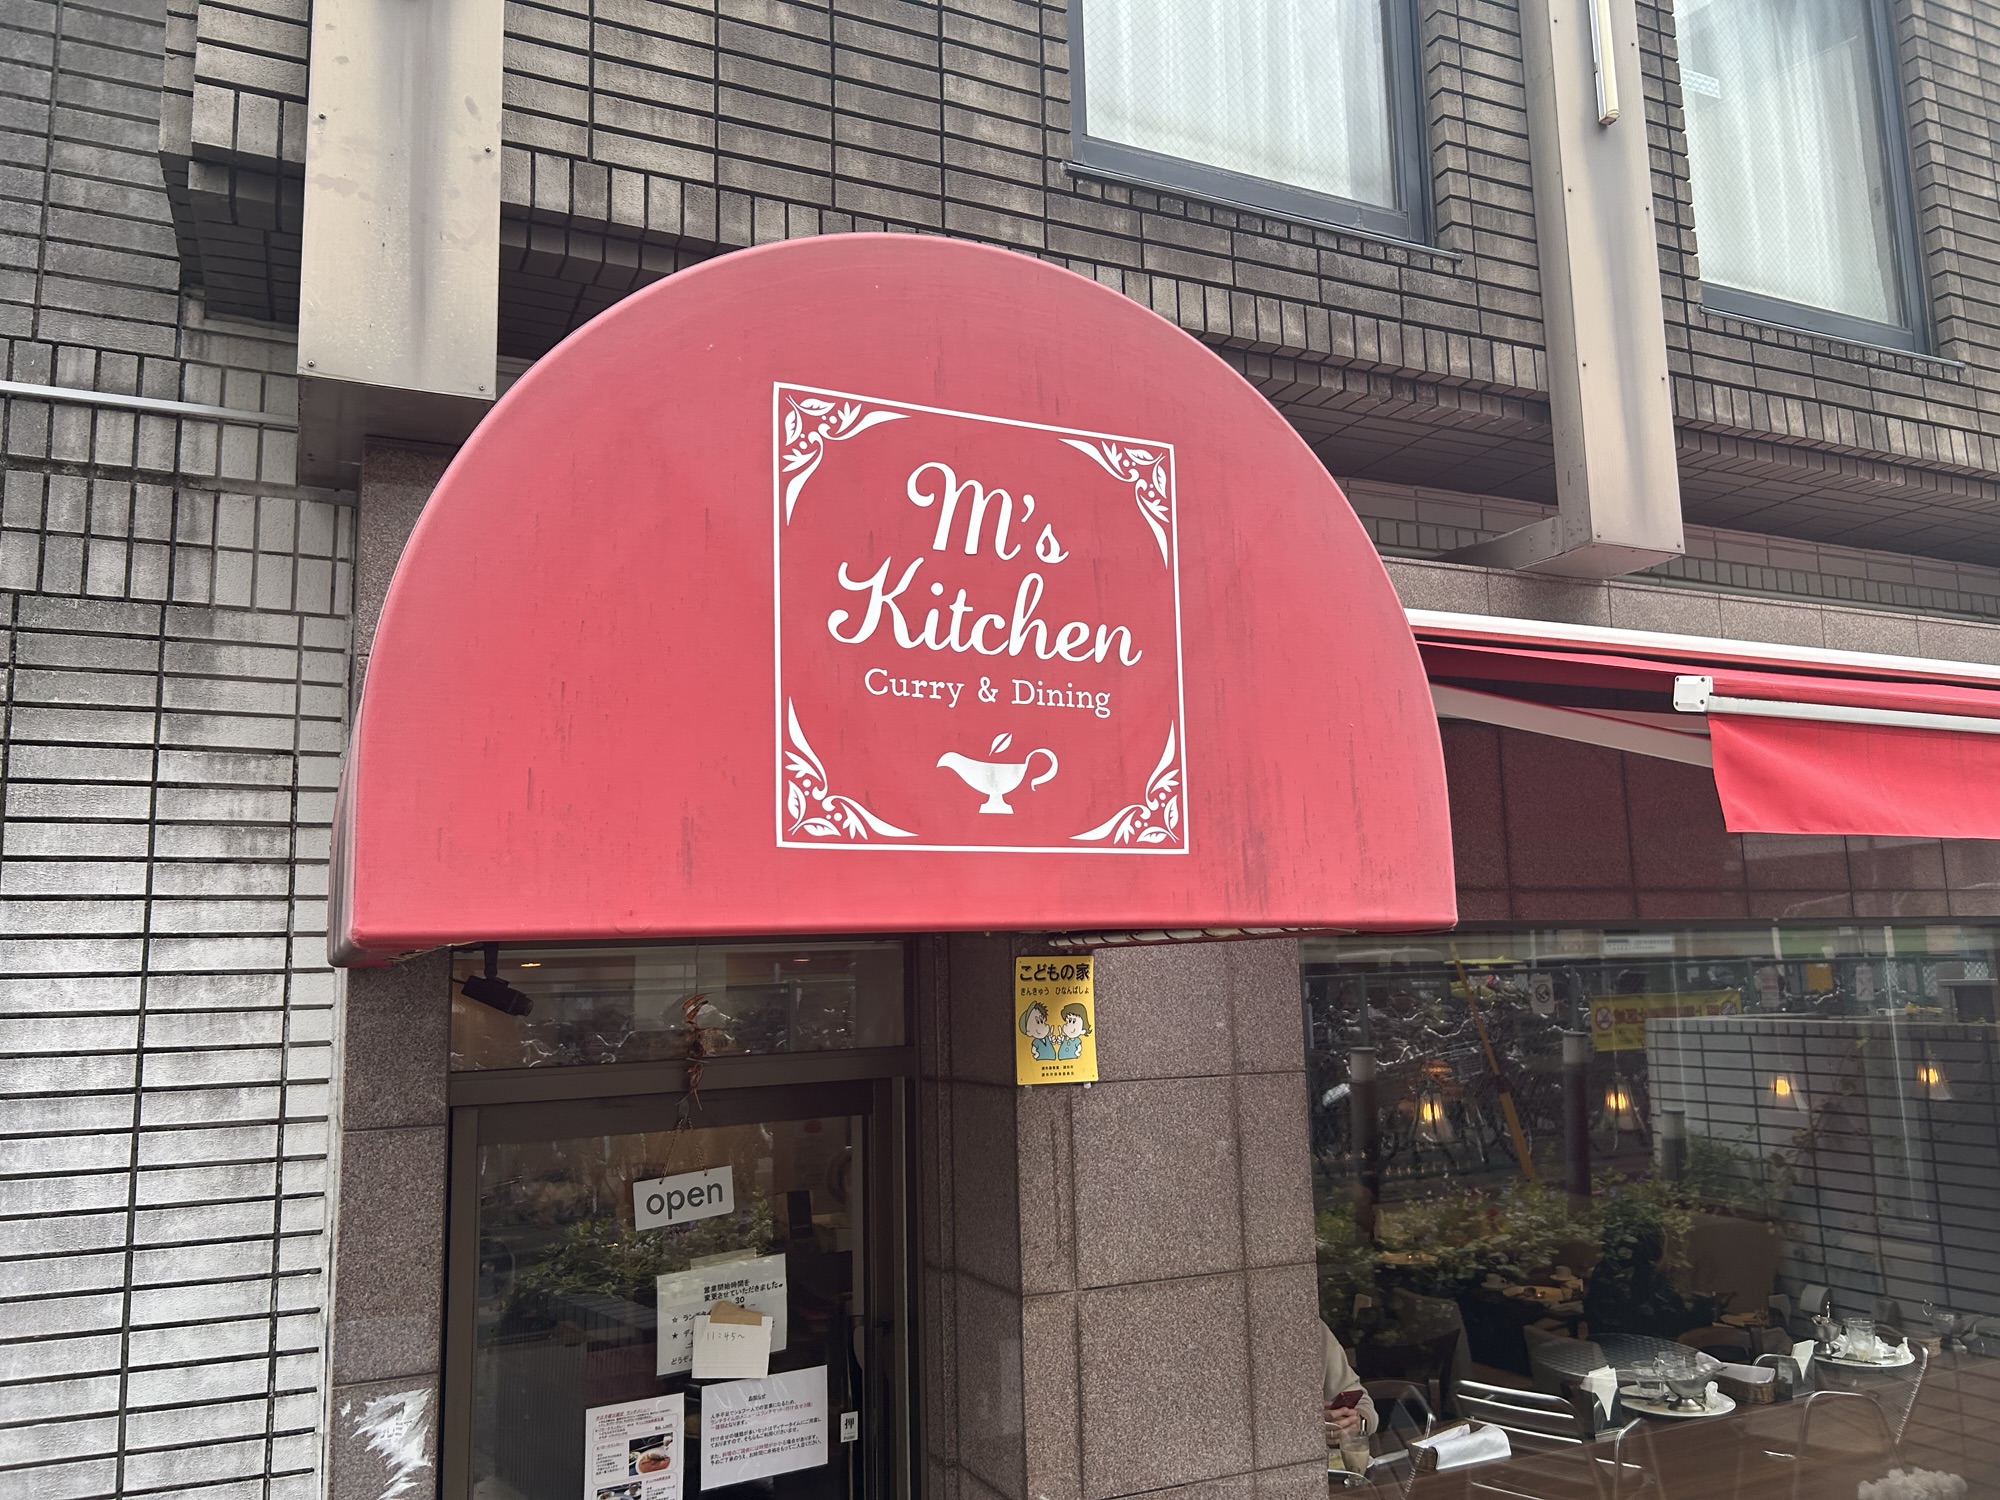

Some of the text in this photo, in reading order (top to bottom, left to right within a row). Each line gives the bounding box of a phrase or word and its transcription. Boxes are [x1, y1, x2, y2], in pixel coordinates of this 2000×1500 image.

[907, 461, 1069, 563] M's
[827, 556, 1143, 666] Kitchen
[864, 668, 1111, 719] Curry & Dining
[1019, 963, 1090, 981] こどもの家
[1020, 985, 1090, 996] きんきゅう ひなんばしょ
[646, 1183, 723, 1220] open
[703, 1279, 750, 1294] 営業開始時間を
